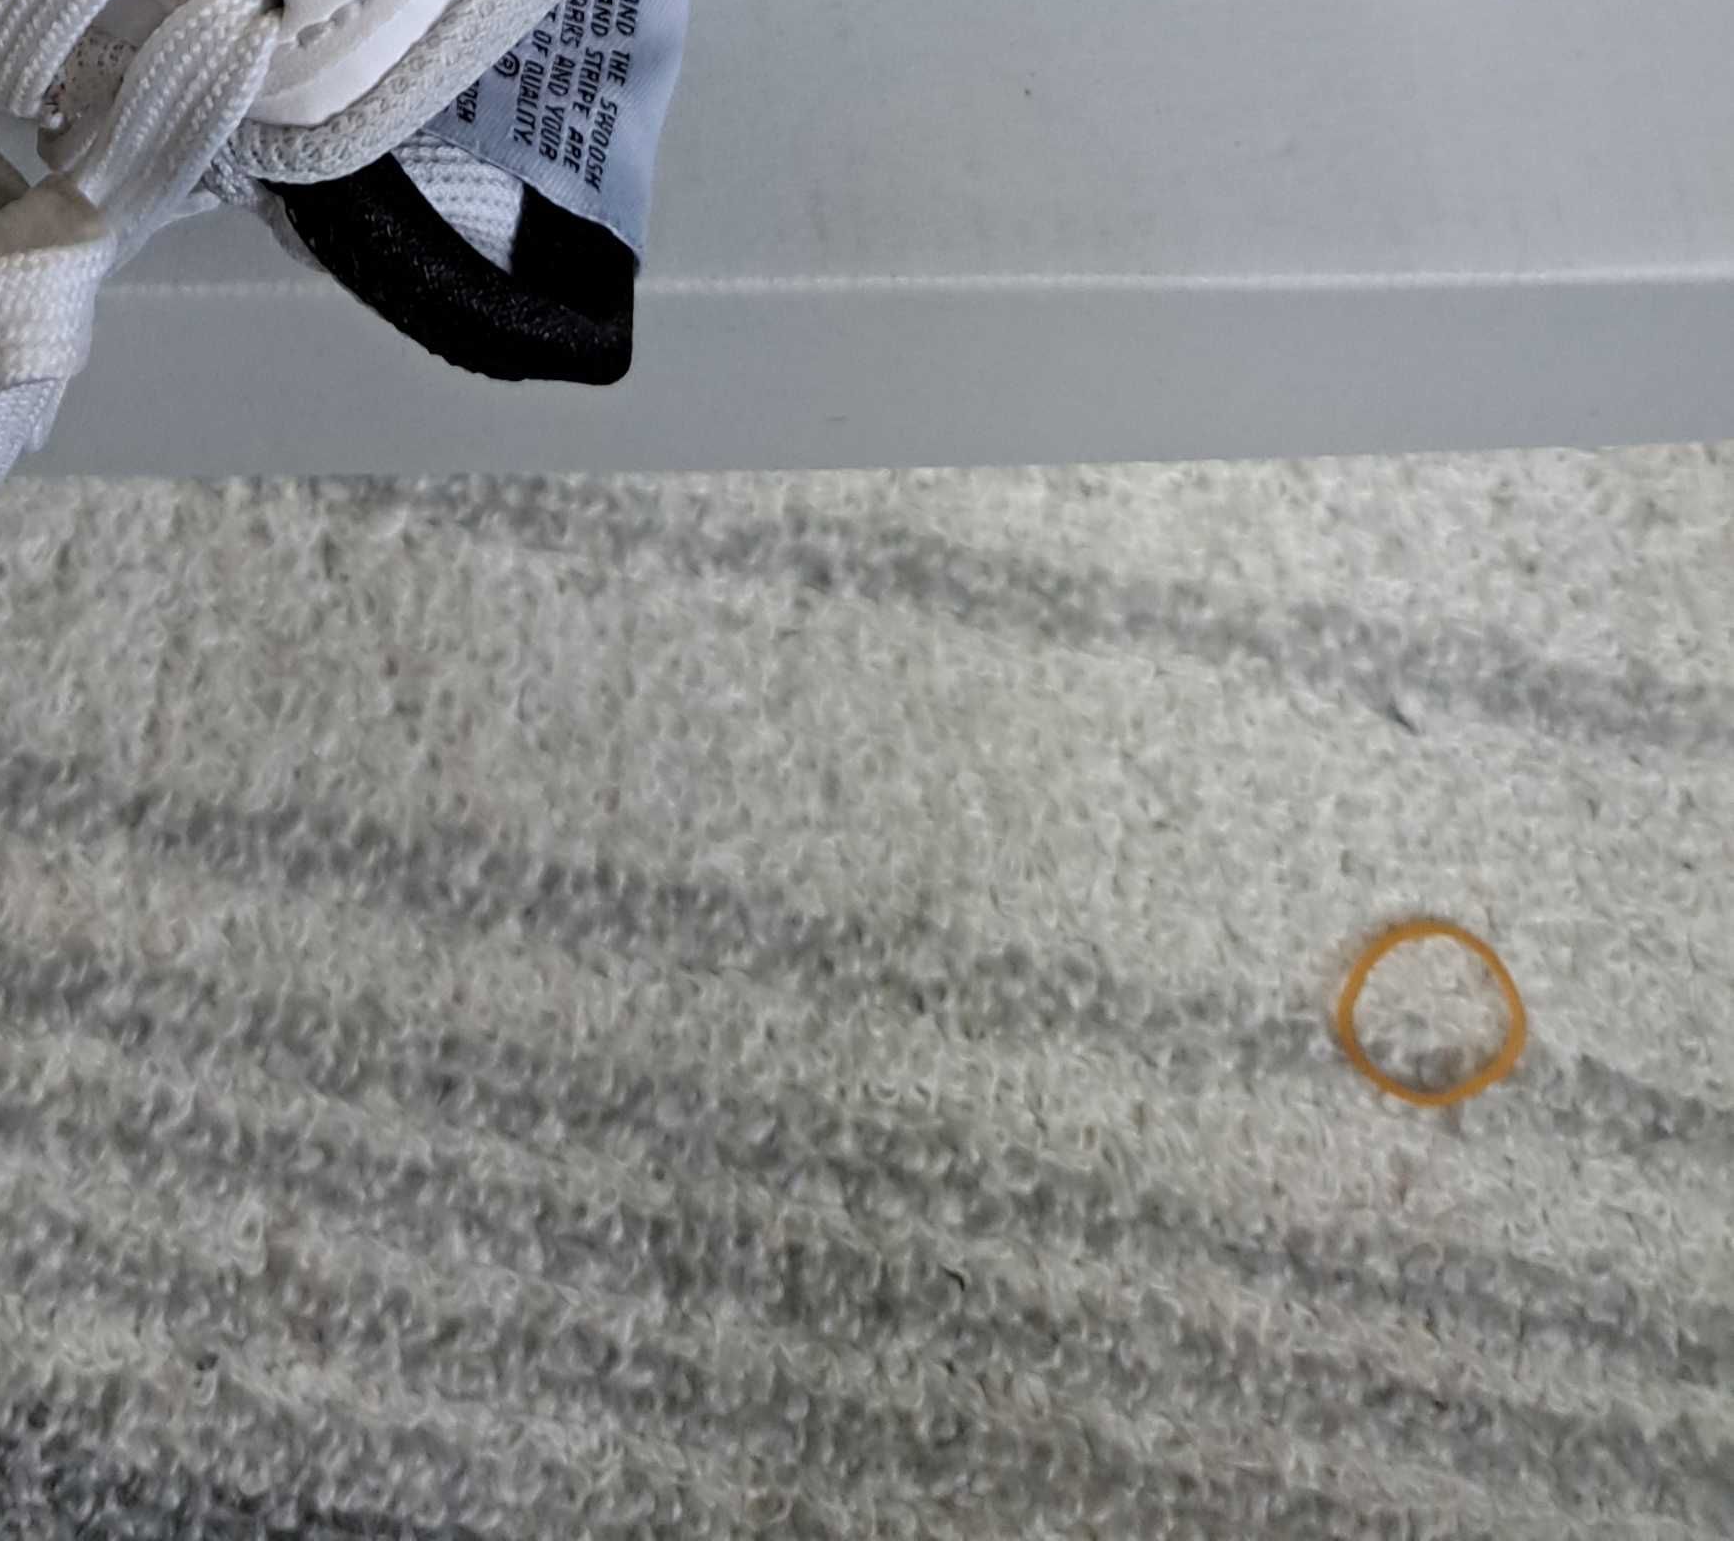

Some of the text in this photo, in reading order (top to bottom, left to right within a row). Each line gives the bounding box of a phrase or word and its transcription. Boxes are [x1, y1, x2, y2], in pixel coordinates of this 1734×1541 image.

[530, 29, 553, 58] OF
[605, 50, 630, 87] THE
[549, 54, 575, 96] AND
[572, 48, 604, 120] STRIPE
[511, 60, 544, 147] QUALITY.
[537, 106, 564, 161] YOUR
[562, 126, 584, 174] ARE
[583, 99, 618, 193] SWOOSH
